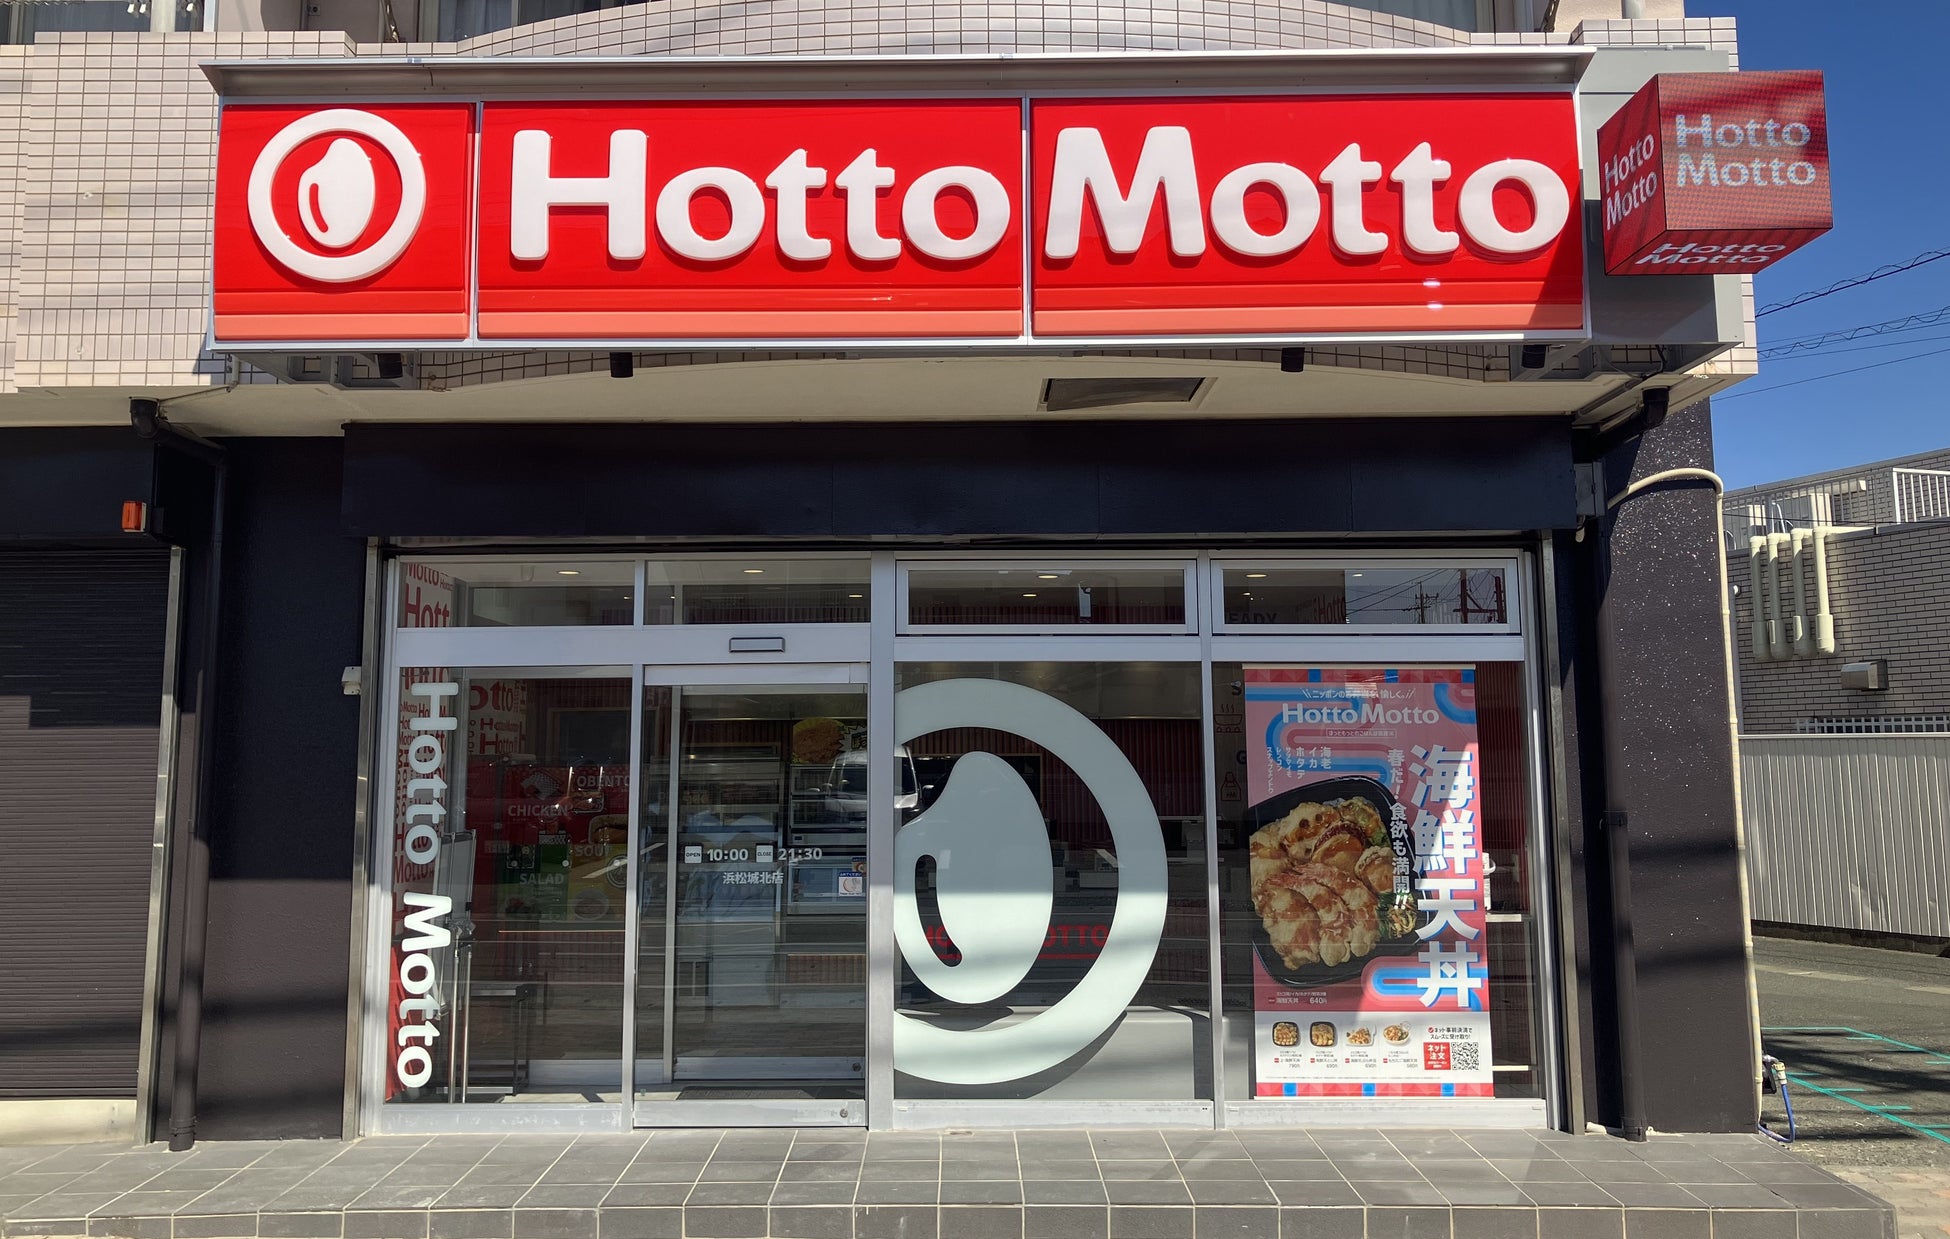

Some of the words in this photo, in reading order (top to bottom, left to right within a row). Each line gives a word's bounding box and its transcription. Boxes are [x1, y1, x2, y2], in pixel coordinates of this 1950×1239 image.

[1675, 113, 1811, 148] Hotto
[1604, 134, 1655, 194] Hotto
[1677, 152, 1817, 187] Motto
[510, 128, 1011, 262] Hotto
[1045, 125, 1571, 259] Motto
[1605, 171, 1658, 232] Motto
[1635, 253, 1770, 265] Motto
[1653, 242, 1786, 254] Hotto
[1282, 703, 1359, 724] Hotto
[1360, 703, 1440, 724] Motto
[1296, 746, 1305, 779] ホタテ
[1309, 746, 1318, 769] イカ
[1320, 746, 1332, 770] 海老
[403, 682, 459, 865] Hotto
[508, 804, 570, 818] CHICKEN
[706, 848, 749, 861] 10:00
[777, 847, 822, 861] 21:30
[519, 873, 566, 886] SALAD
[722, 871, 784, 885] 浜松城北店
[1409, 744, 1482, 1008] 海鮮天丼
[394, 891, 452, 1088] Motto
[1427, 1044, 1446, 1052] ネット
